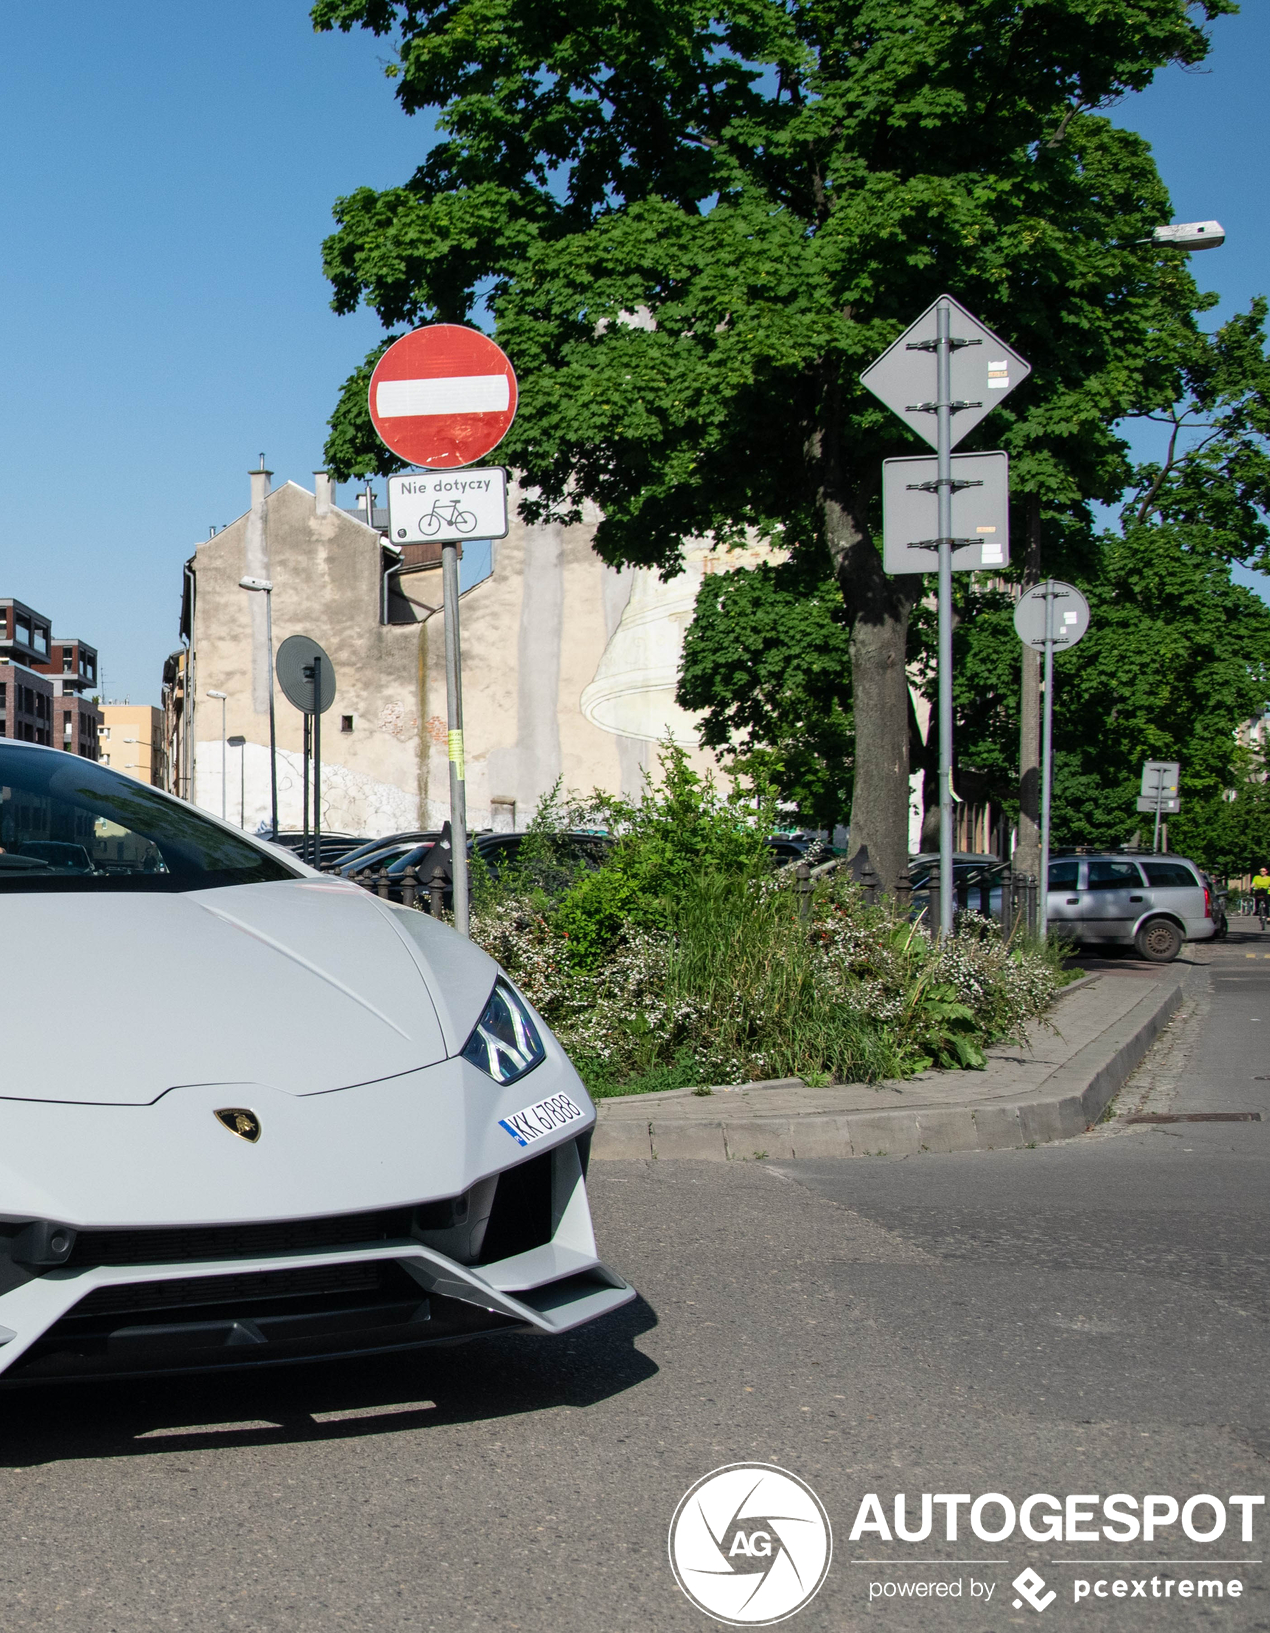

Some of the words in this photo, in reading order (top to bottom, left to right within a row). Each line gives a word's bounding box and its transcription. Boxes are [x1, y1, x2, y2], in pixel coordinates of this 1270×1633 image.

[401, 482, 427, 495] Nie
[433, 479, 491, 494] dotyczy
[508, 1112, 544, 1141] KK
[532, 1094, 581, 1130] 67888
